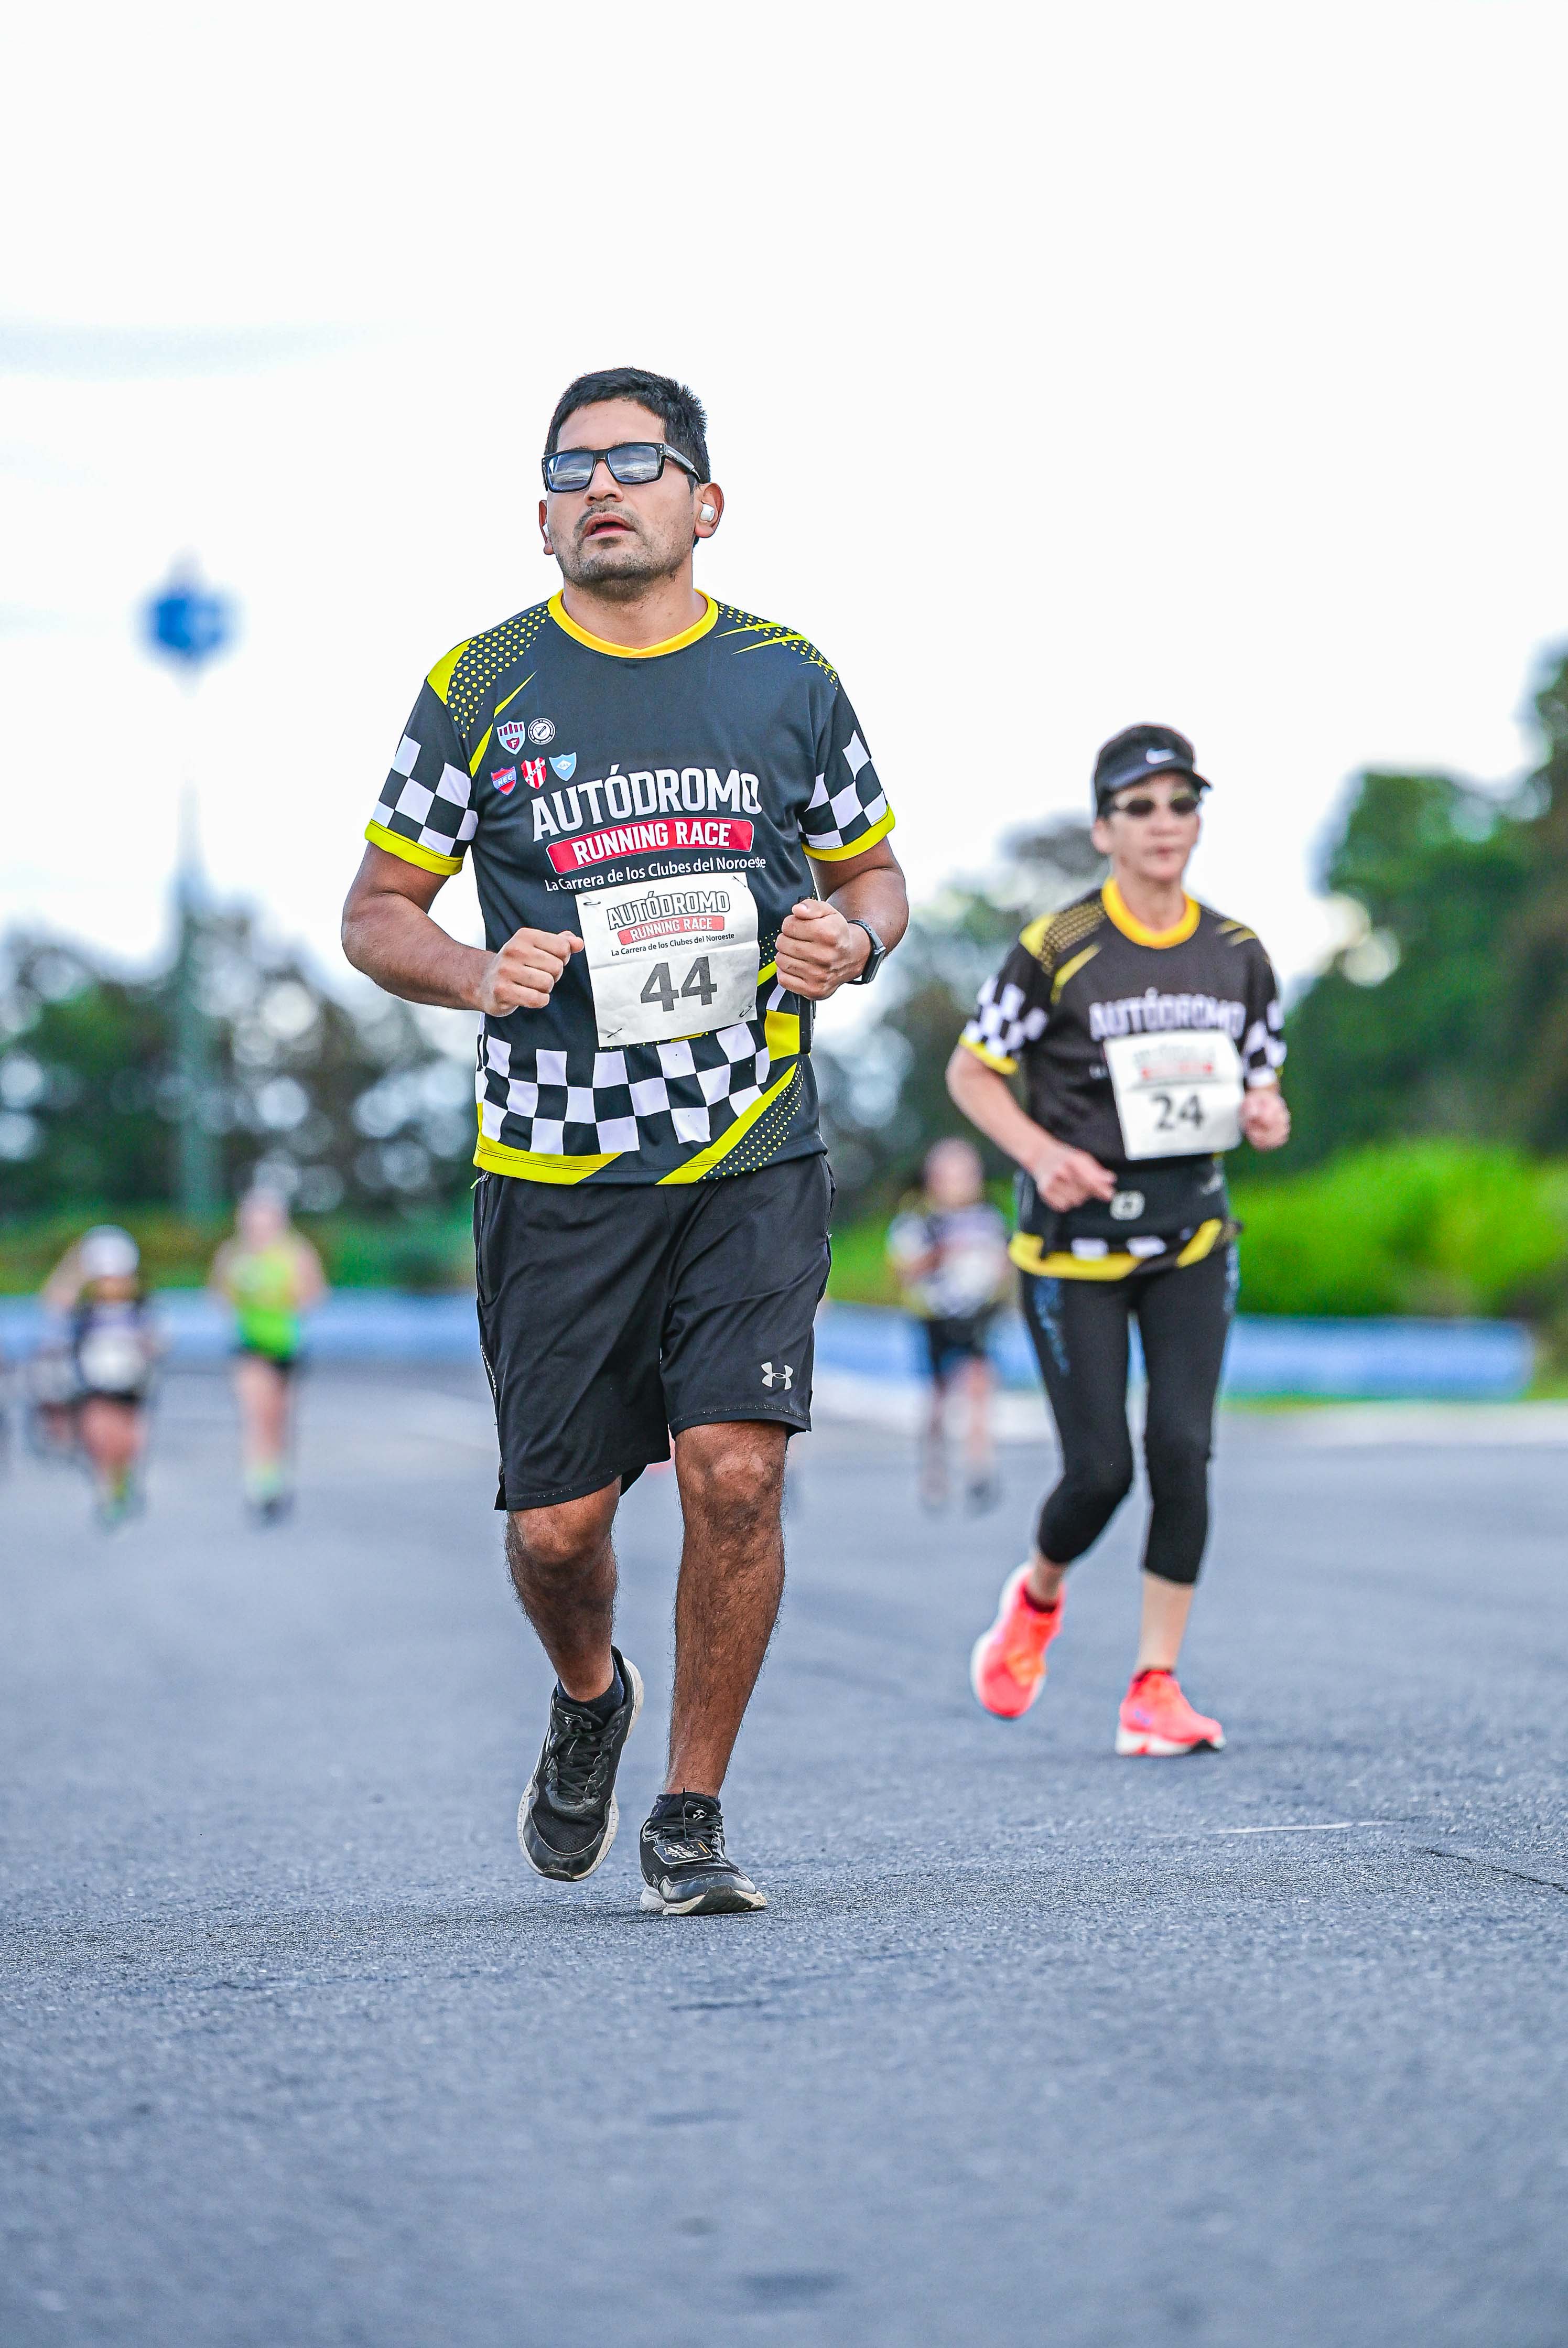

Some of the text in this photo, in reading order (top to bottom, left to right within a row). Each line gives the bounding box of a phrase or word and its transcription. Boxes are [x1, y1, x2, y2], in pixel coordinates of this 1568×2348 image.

[510, 739, 517, 749] F
[498, 774, 513, 786] NEC
[531, 764, 763, 842] AUTÓDROMO
[571, 821, 732, 866] RUNNING RACE
[545, 856, 766, 891] La Carrera de los Clubes del Noroeste
[606, 891, 730, 930] AUTÓDROMO
[621, 946, 646, 955] Carrera
[669, 938, 693, 947] Clubes
[694, 935, 705, 943] del
[706, 933, 734, 942] Noroeste
[630, 918, 713, 941] RUNNING RACE
[640, 956, 717, 1013] 44
[1150, 1090, 1205, 1132] 24
